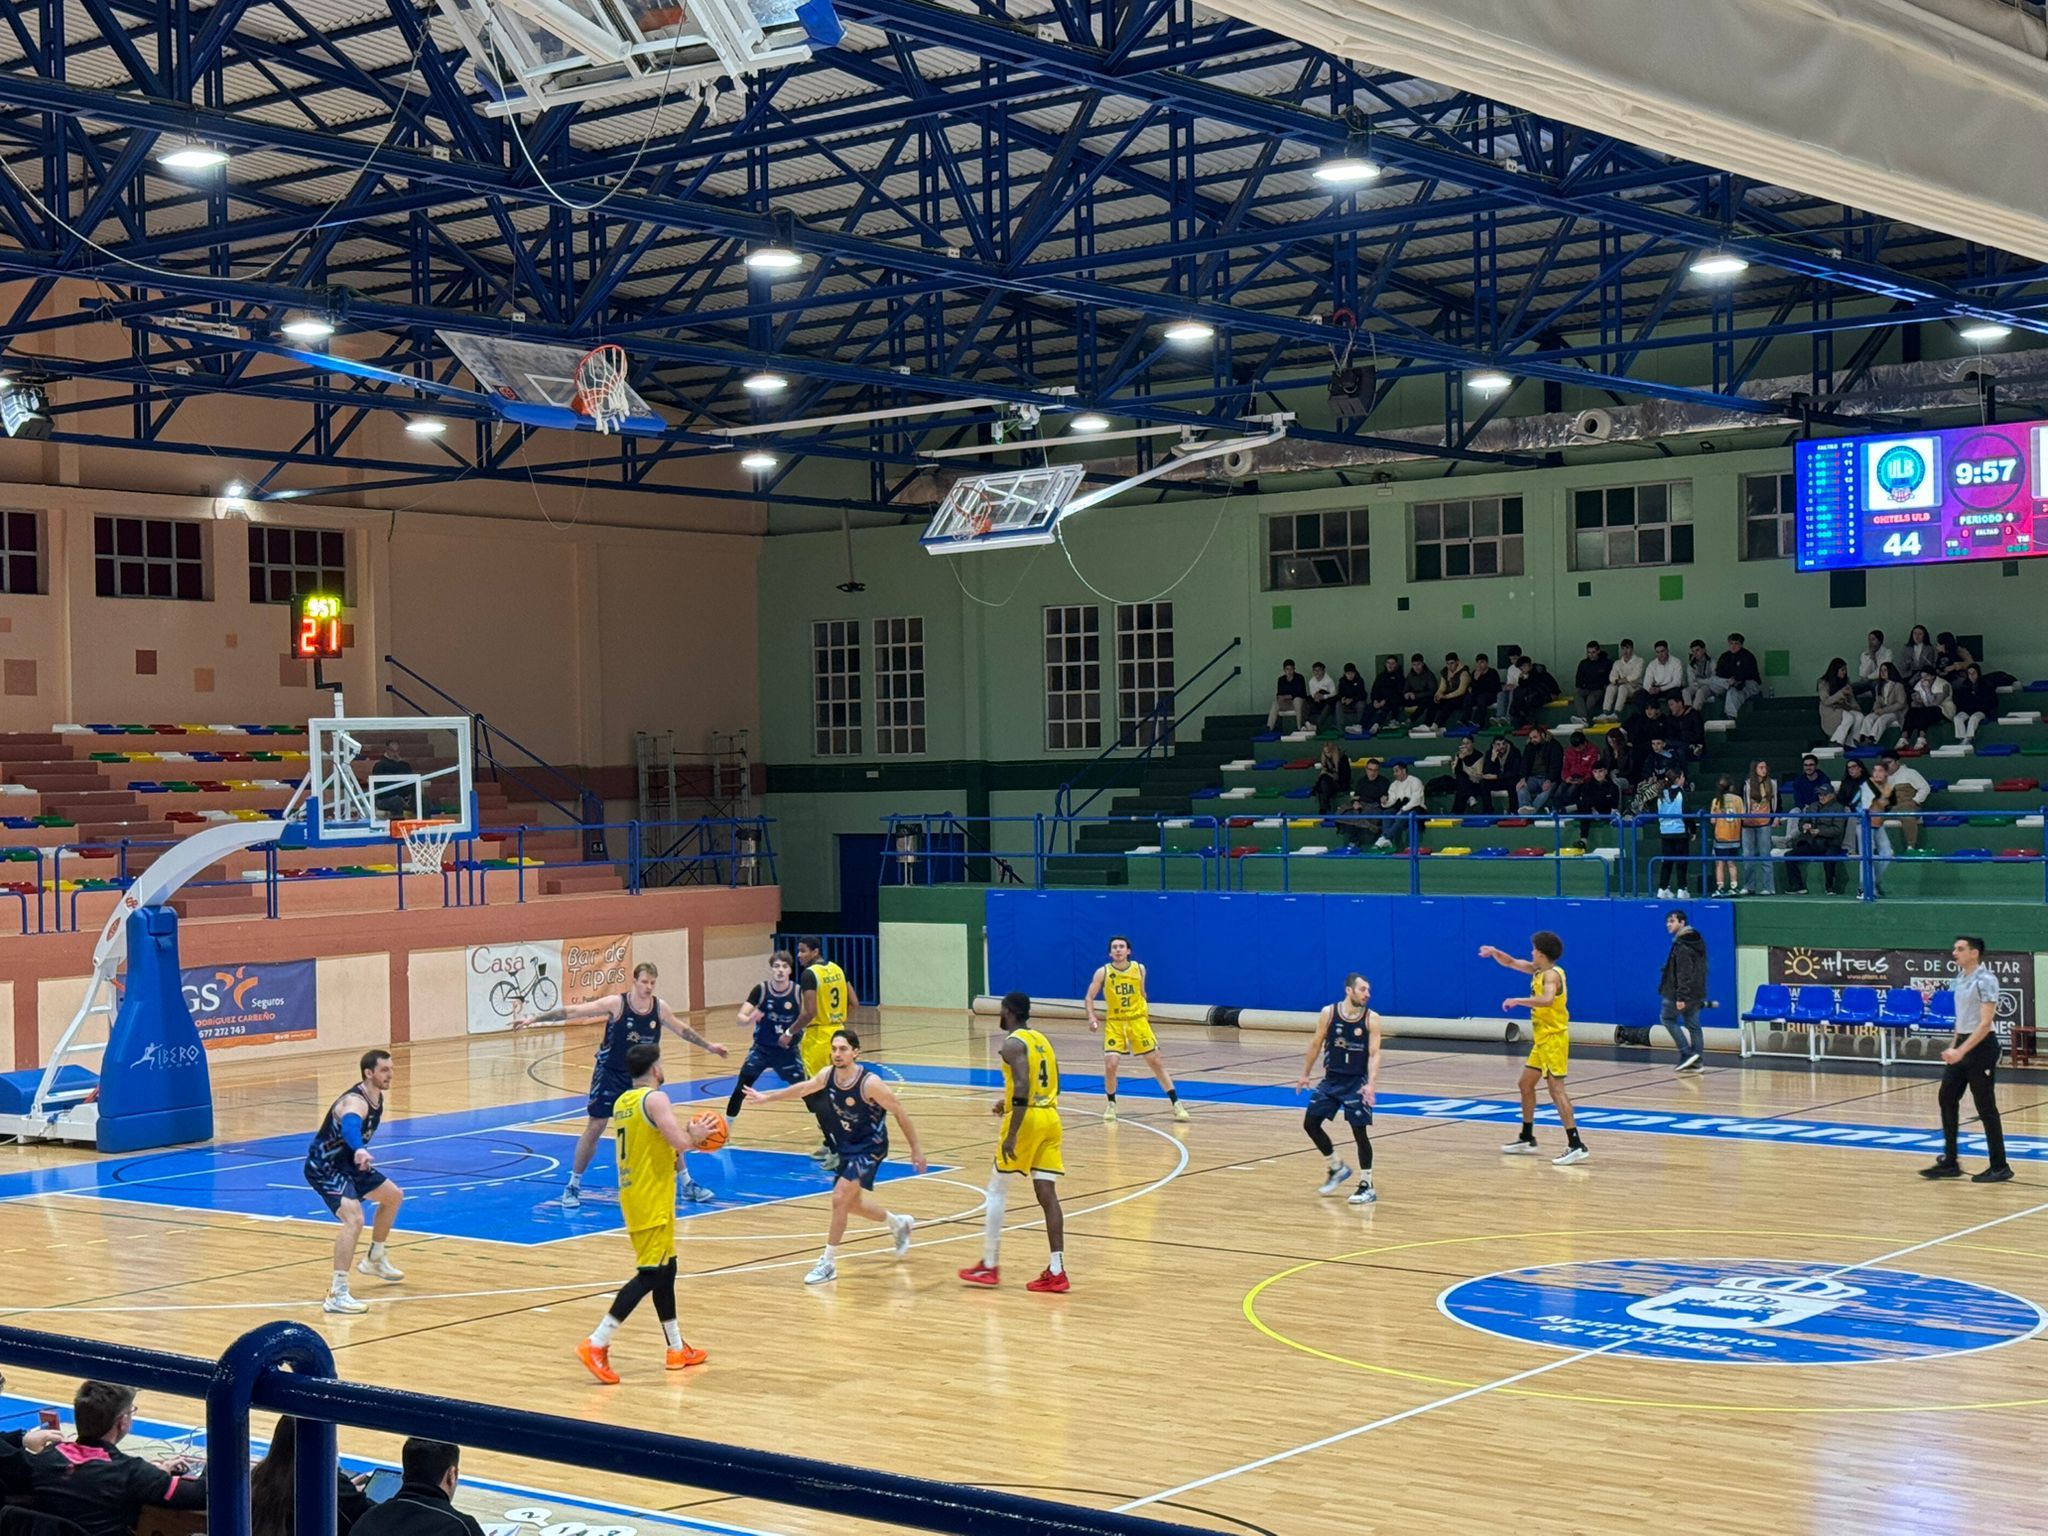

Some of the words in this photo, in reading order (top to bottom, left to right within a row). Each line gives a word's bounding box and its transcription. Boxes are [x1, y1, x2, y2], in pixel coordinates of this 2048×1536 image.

[1887, 458, 1914, 478] ULB
[1955, 458, 2017, 485] 9:57
[1959, 513, 2004, 525] PERIODO
[2005, 512, 2015, 522] 4
[1882, 531, 1922, 557] 44
[301, 618, 337, 652] 21
[471, 946, 526, 974] Casa
[567, 946, 599, 966] Bar
[604, 942, 626, 962] de
[568, 966, 626, 989] Tapas
[1905, 960, 1919, 971] C.
[1924, 960, 1941, 972] DE
[1946, 960, 2020, 974] GIALTAR
[829, 986, 840, 1009] 3
[1115, 982, 1135, 995] CBA
[251, 997, 285, 1009] Seguros
[1121, 996, 1131, 1008] 21
[195, 1015, 237, 1027] ODRÍGUEZ
[237, 1011, 276, 1022] CARREÑO
[214, 1027, 229, 1036] 272
[230, 1025, 246, 1035] 743
[1038, 1059, 1049, 1088] 4
[617, 1127, 626, 1160] 7
[1533, 1315, 1777, 1348] Ayuntamiento
[1539, 1323, 1584, 1334] de
[1585, 1328, 1632, 1339] La
